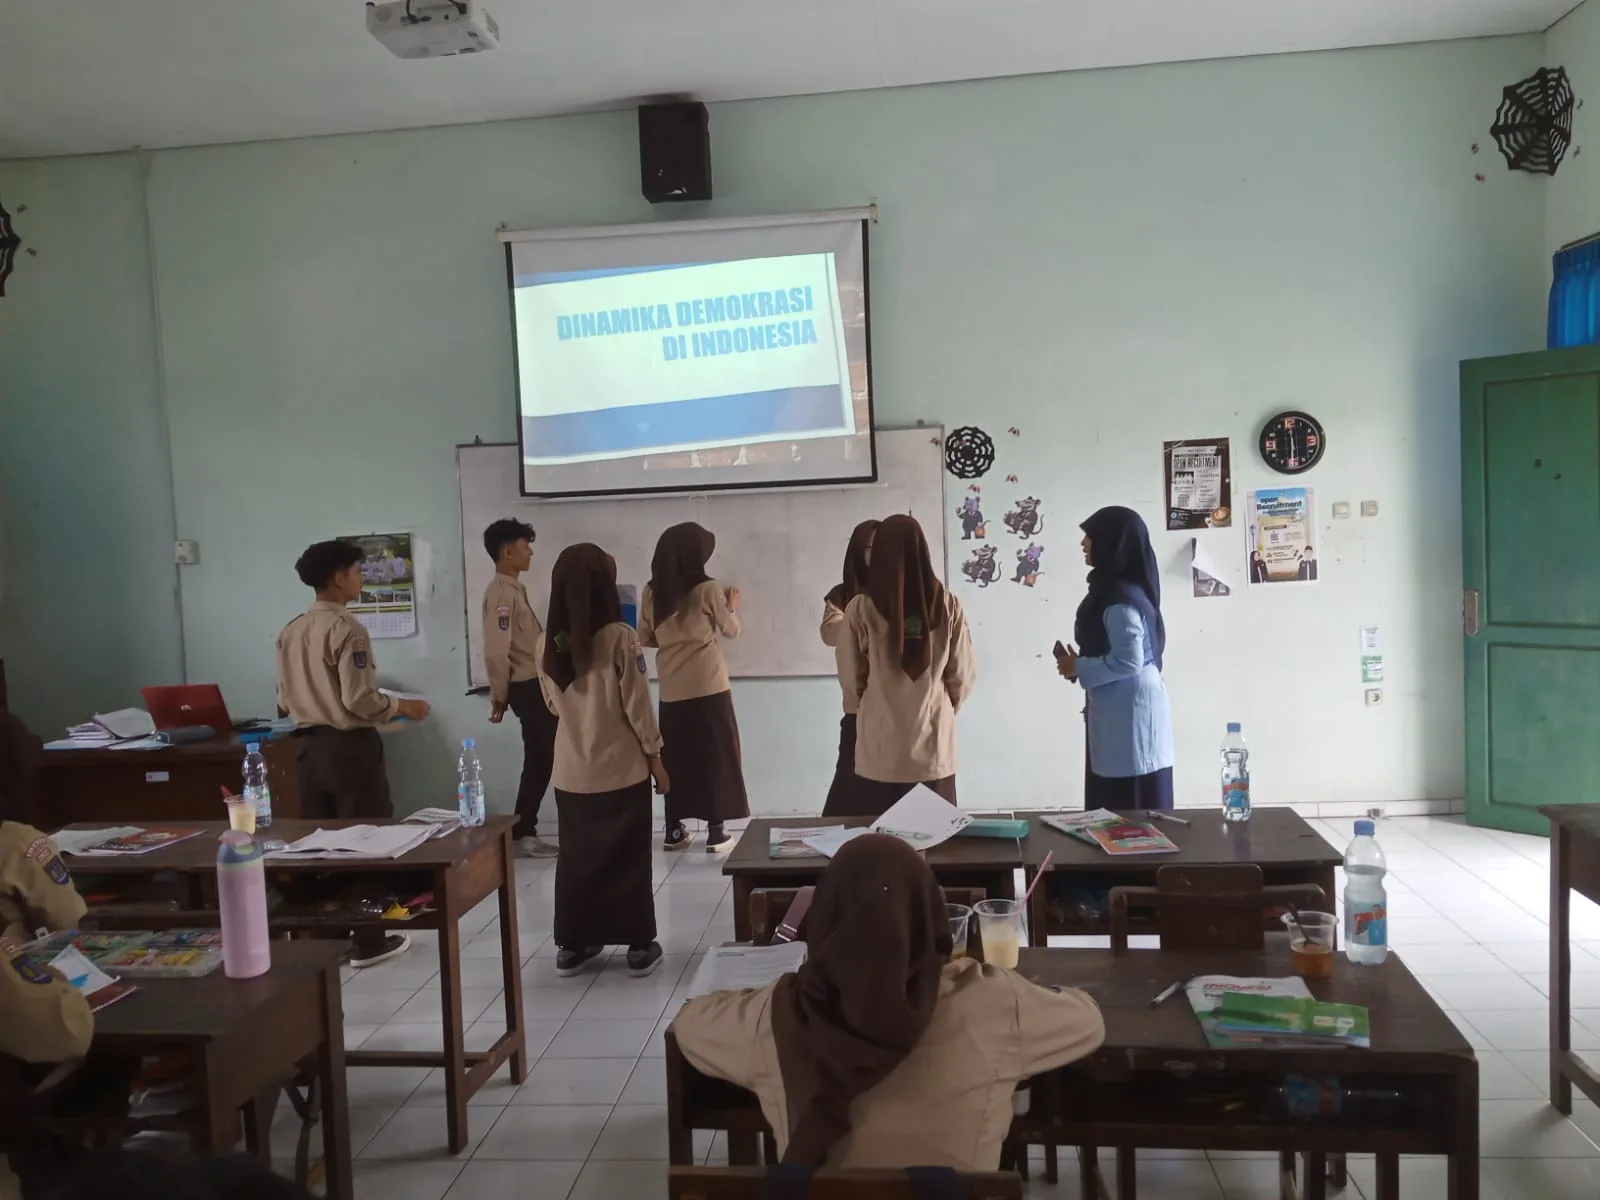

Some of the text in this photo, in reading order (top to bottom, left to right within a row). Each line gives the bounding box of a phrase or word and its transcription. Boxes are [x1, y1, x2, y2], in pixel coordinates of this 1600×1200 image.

[556, 285, 813, 340] DINAMIKA DEMOKRASI
[662, 319, 818, 361] DI INDONESIA
